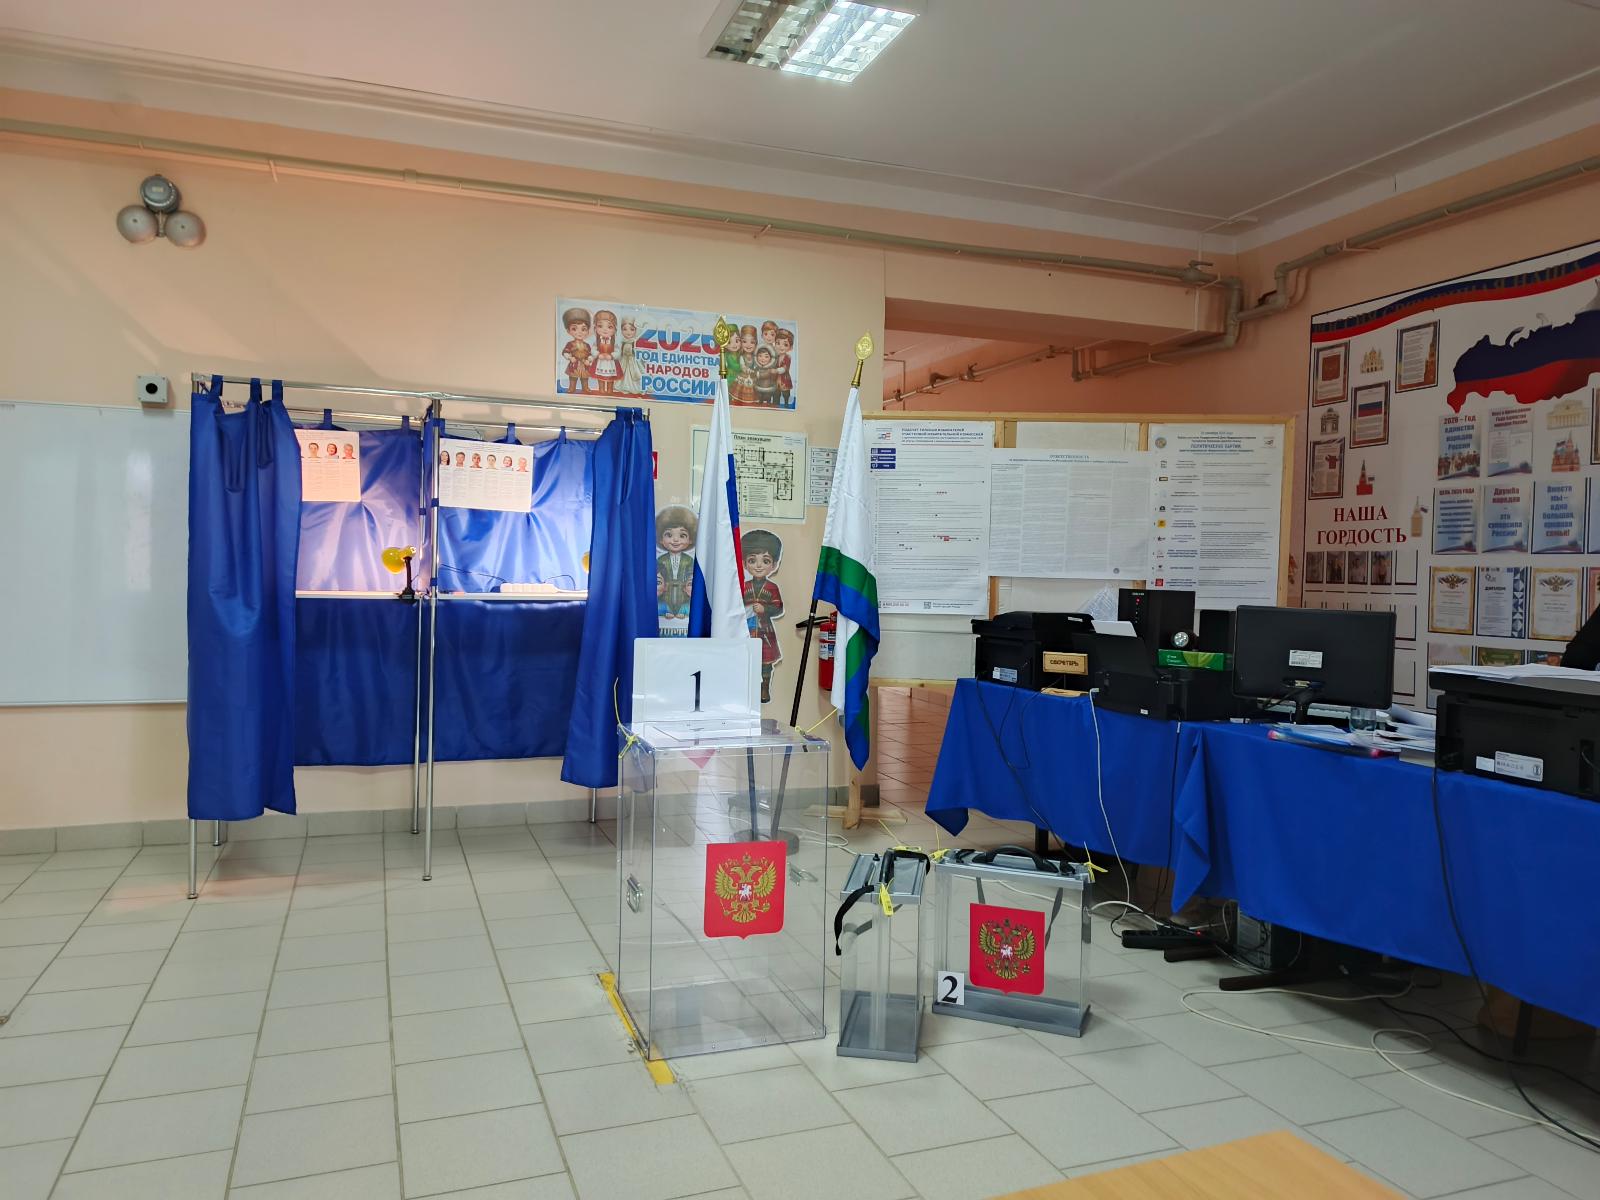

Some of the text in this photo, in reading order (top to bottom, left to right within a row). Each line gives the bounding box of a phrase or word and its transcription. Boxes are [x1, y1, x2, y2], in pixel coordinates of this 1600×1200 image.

[636, 350, 721, 366] ГОД ЕДИНСТВА
[646, 363, 710, 379] НАРОДОВ
[641, 375, 716, 396] РОССИИ
[1493, 487, 1520, 496] Дружба
[1333, 505, 1388, 522] НАША
[1317, 527, 1407, 546] ГОРДОСТЬ
[690, 670, 705, 713] 1
[941, 975, 959, 1004] 2
